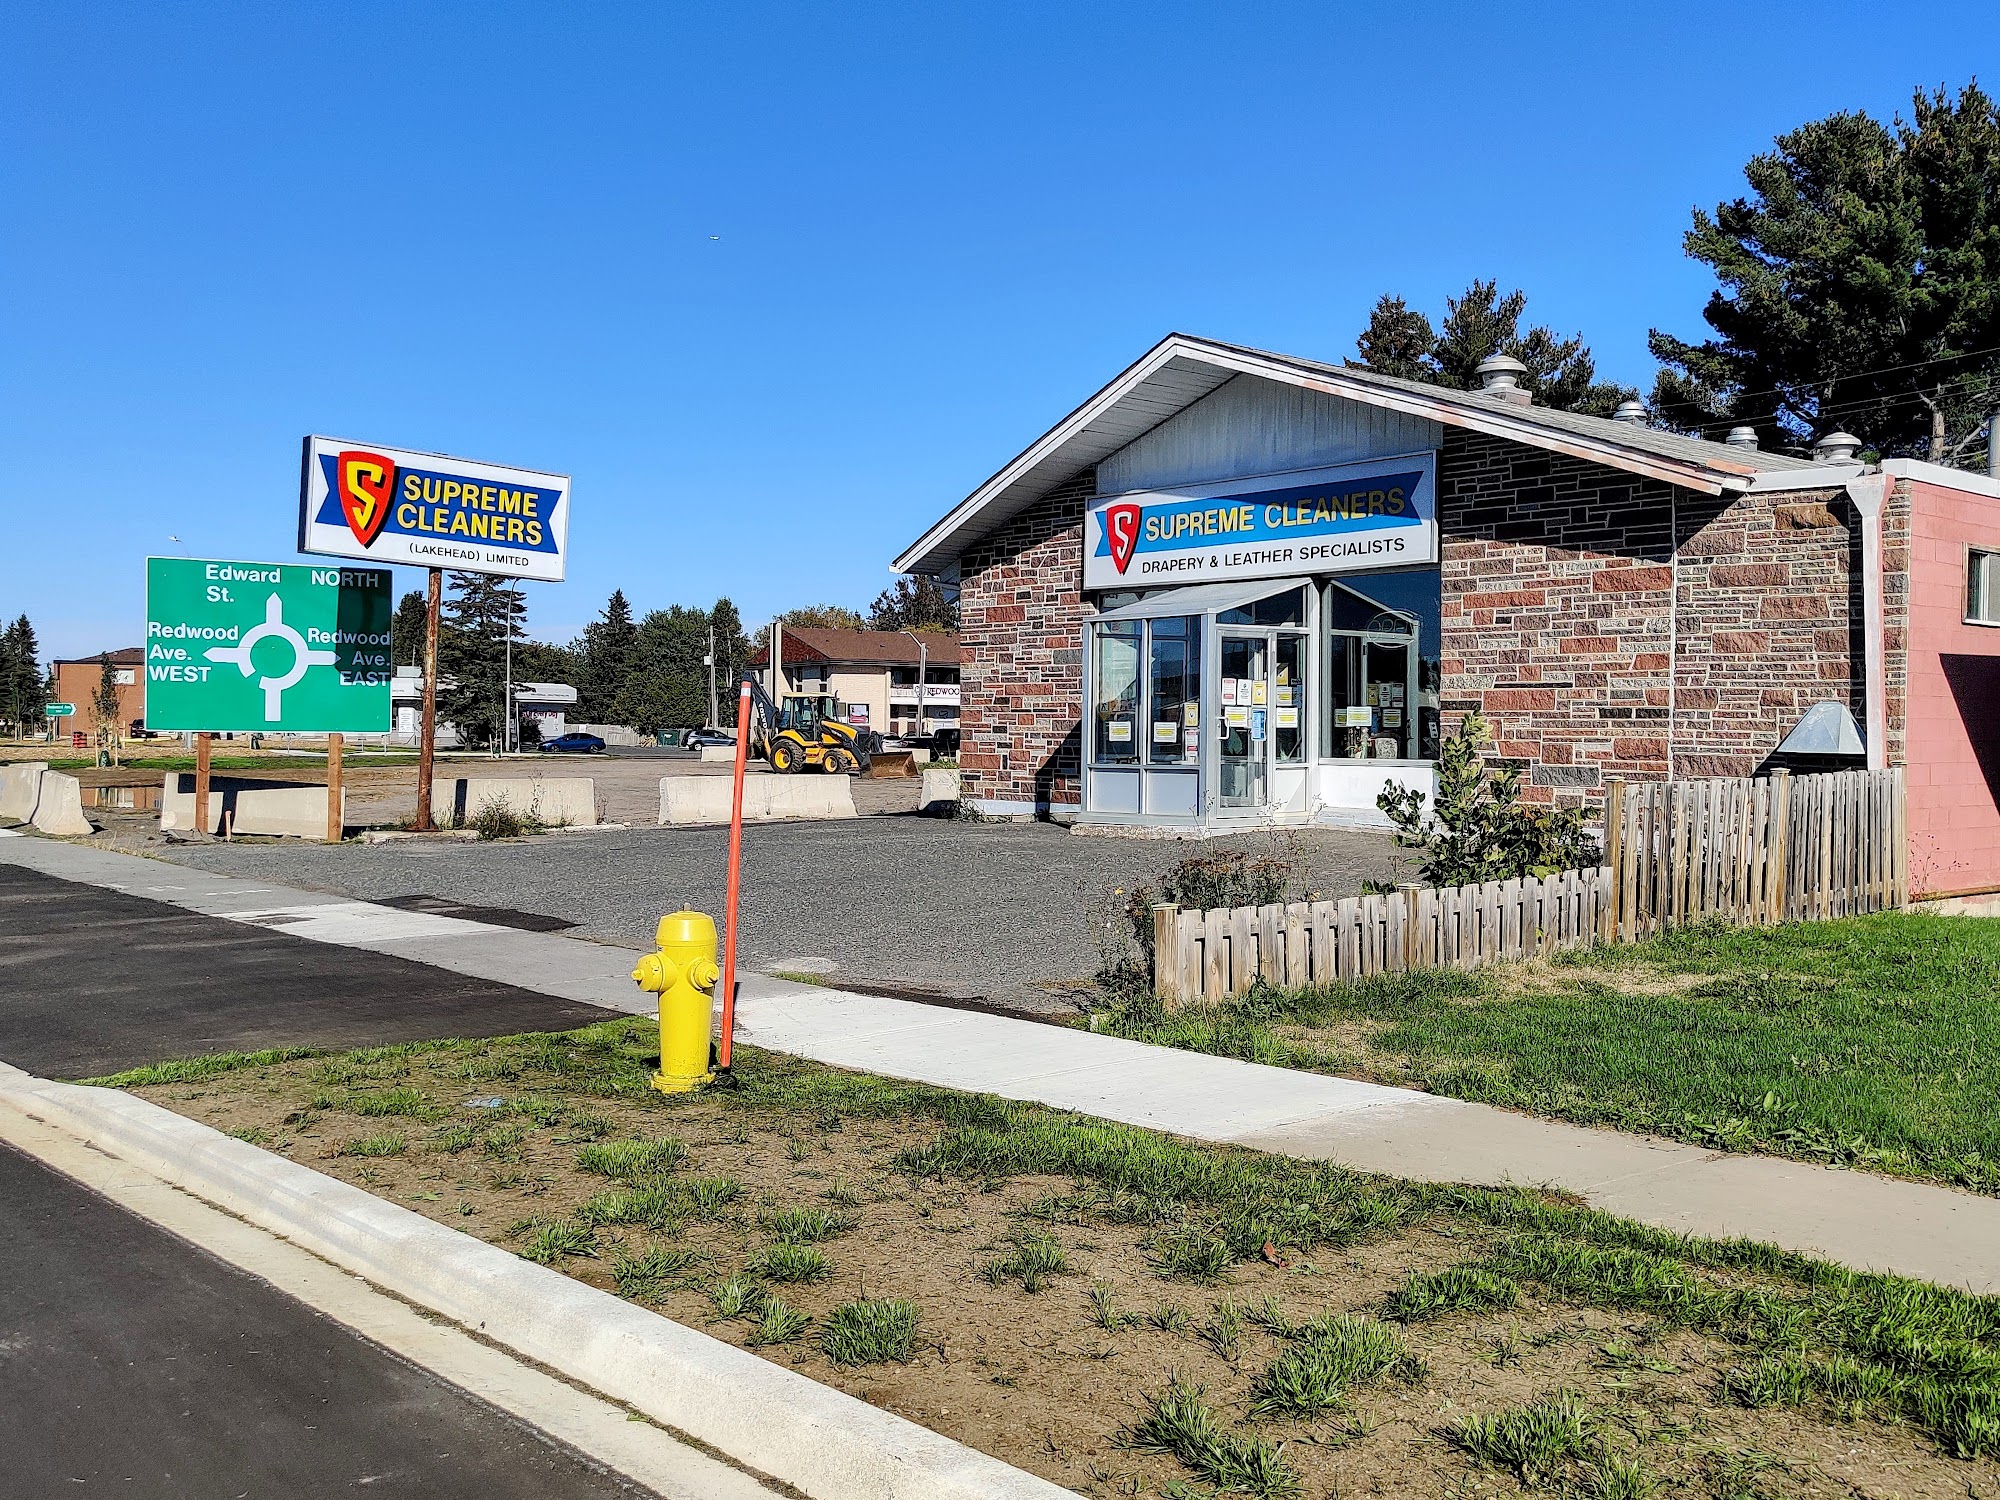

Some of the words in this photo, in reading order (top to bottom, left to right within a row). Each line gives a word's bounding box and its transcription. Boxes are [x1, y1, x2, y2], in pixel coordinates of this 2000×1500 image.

[403, 474, 539, 518] SUPREME
[1145, 504, 1255, 542] SUPREME
[1264, 487, 1406, 527] CLEANERS
[396, 503, 543, 546] CLEANERS
[409, 542, 480, 561] (LAKEHEAD)
[486, 552, 529, 567] LIMITED
[1142, 556, 1205, 574] DRAPERY
[1209, 555, 1219, 568] &
[1224, 548, 1293, 567] LEATHER
[1299, 538, 1405, 560] SPECIALISTS
[205, 564, 281, 583] Edward
[311, 570, 379, 588] NORTH
[206, 586, 235, 603] St.
[148, 621, 239, 641] Redwood
[307, 627, 390, 646] Redwood
[149, 644, 192, 661] Ave.
[351, 651, 390, 667] Ave.
[149, 665, 211, 683] WEST
[339, 671, 390, 687] EAST
[758, 702, 768, 729] VOLVO
